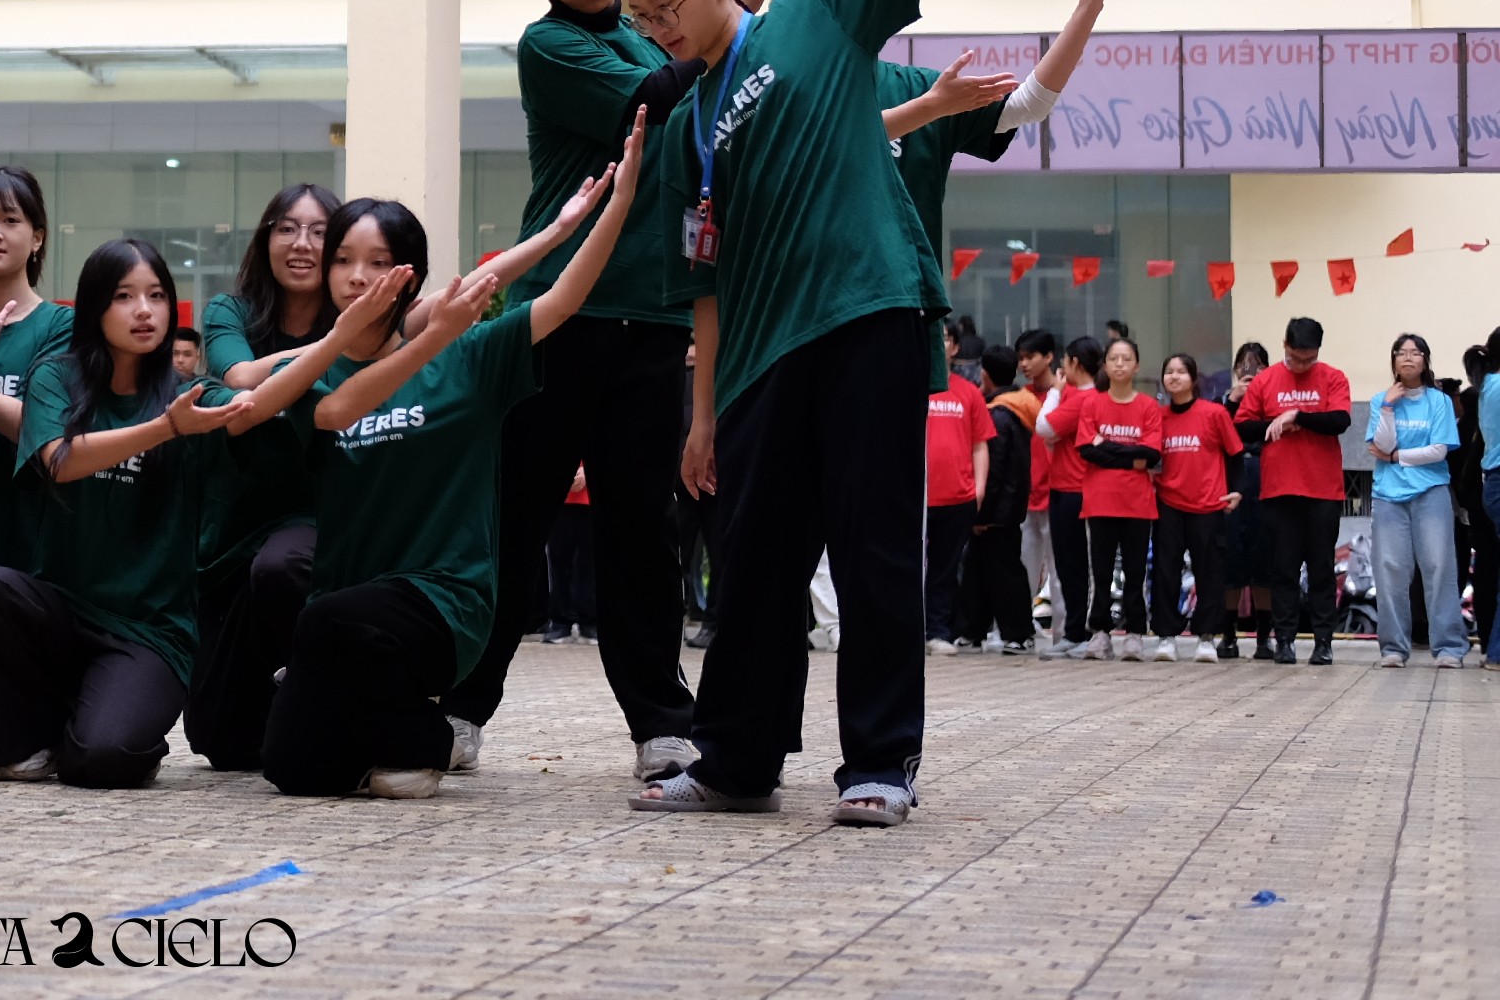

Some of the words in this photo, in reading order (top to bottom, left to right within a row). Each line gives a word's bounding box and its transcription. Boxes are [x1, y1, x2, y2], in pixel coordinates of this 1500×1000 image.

[713, 64, 775, 150] AVRES
[929, 399, 964, 412] ARINA
[337, 405, 426, 437] VERES
[1100, 424, 1141, 438] FARINA
[1164, 434, 1201, 448] ARINA
